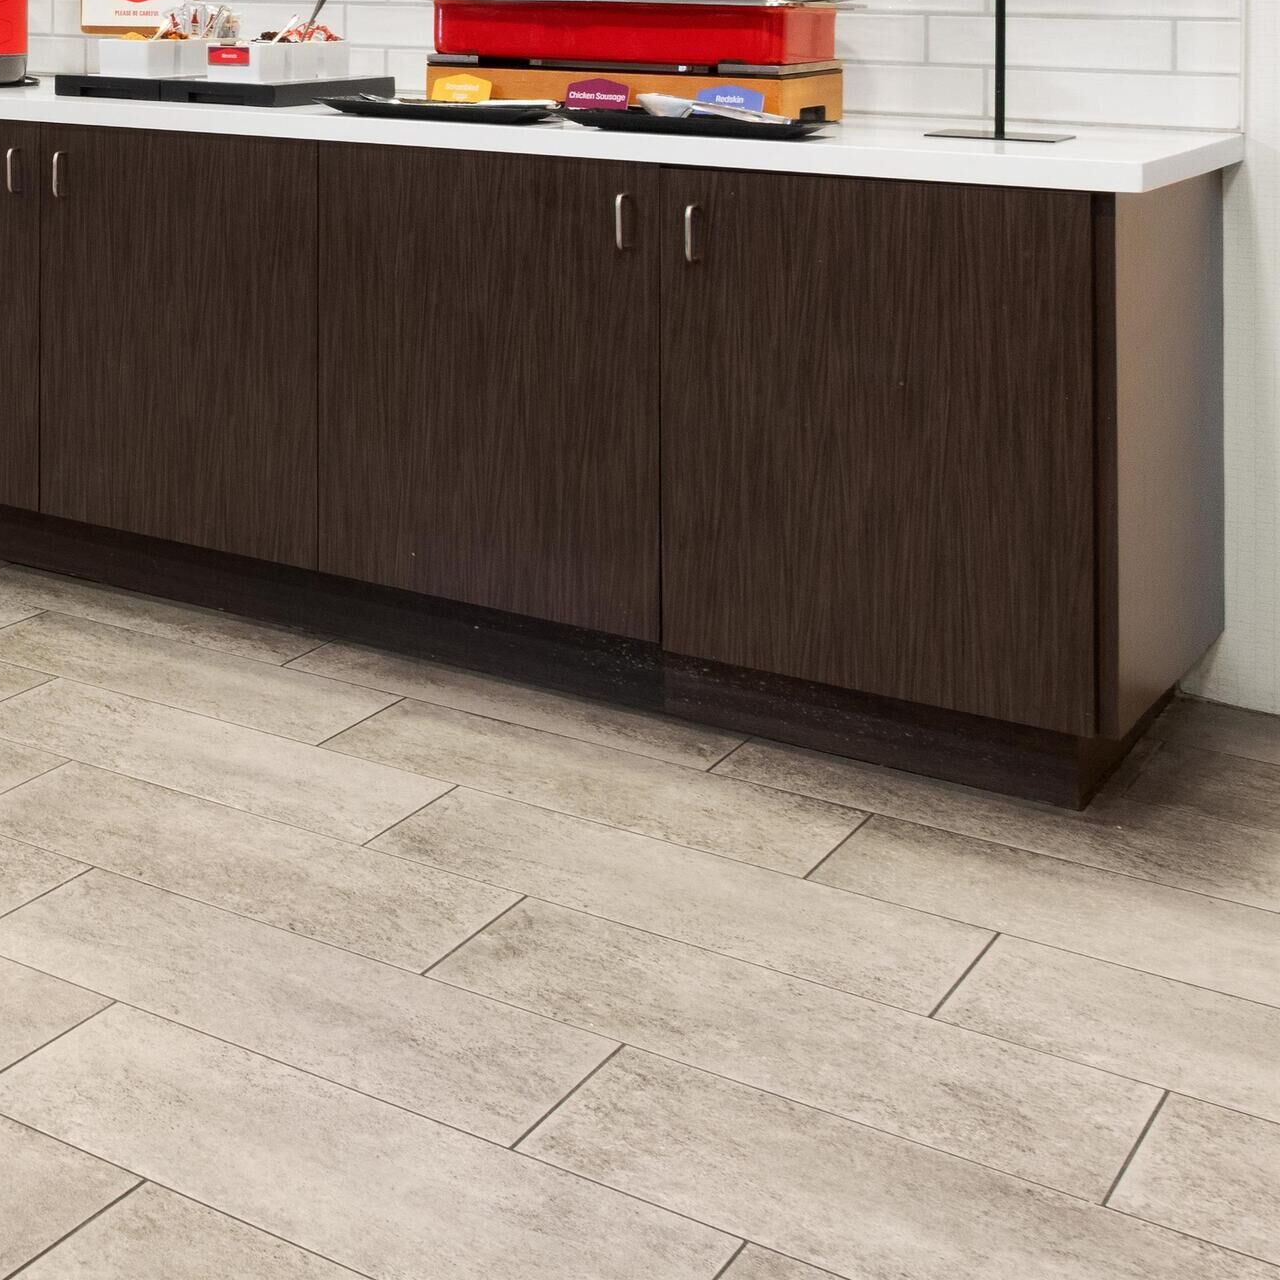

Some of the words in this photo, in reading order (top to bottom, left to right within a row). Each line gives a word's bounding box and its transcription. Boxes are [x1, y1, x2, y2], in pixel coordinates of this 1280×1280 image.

[569, 91, 595, 99] Chicken
[595, 92, 626, 102] Sausage
[715, 95, 744, 103] Redskin
